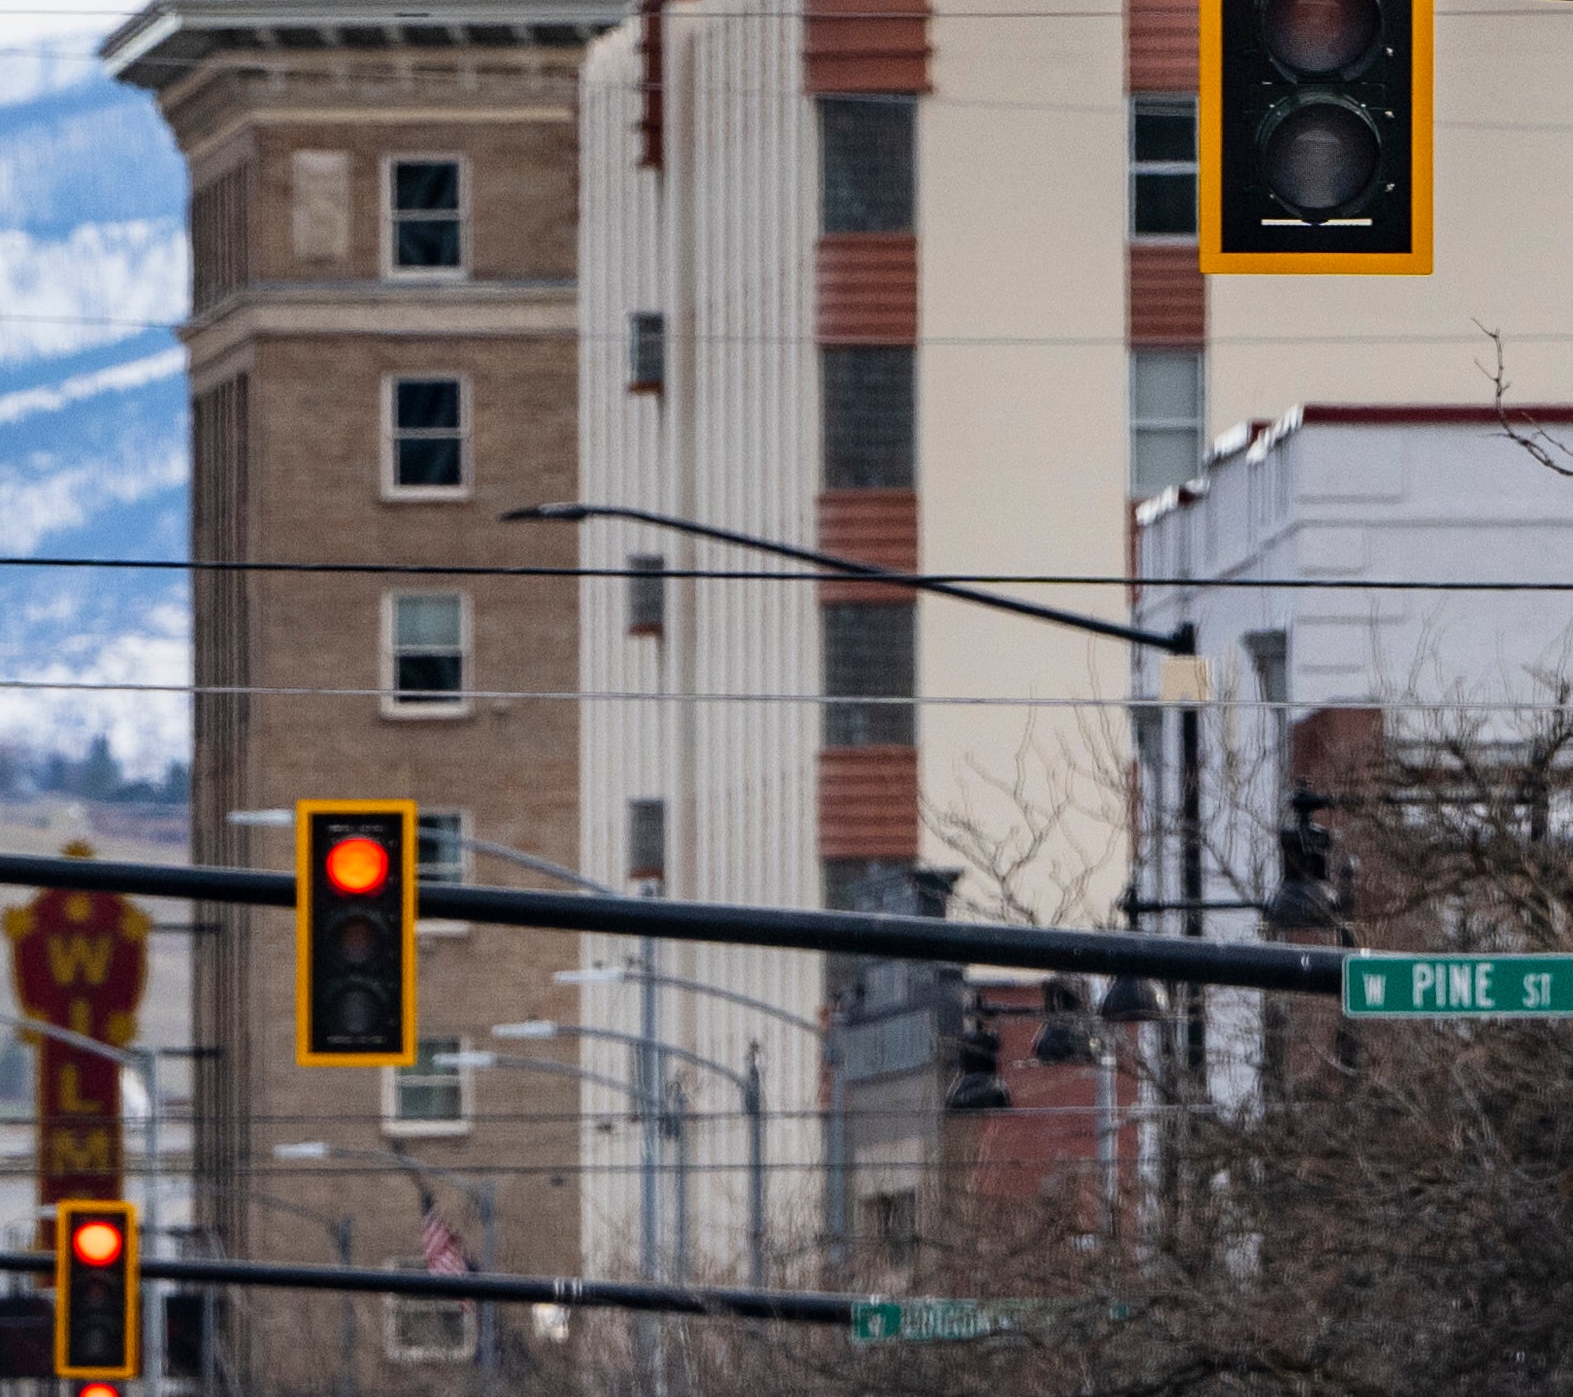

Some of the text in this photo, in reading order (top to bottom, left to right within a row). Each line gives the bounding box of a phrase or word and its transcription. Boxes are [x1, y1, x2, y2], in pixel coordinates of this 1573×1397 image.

[1362, 971, 1387, 1008] W
[1411, 961, 1496, 1009] PINE
[1521, 971, 1553, 1009] ST
[47, 932, 113, 1202] WILM
